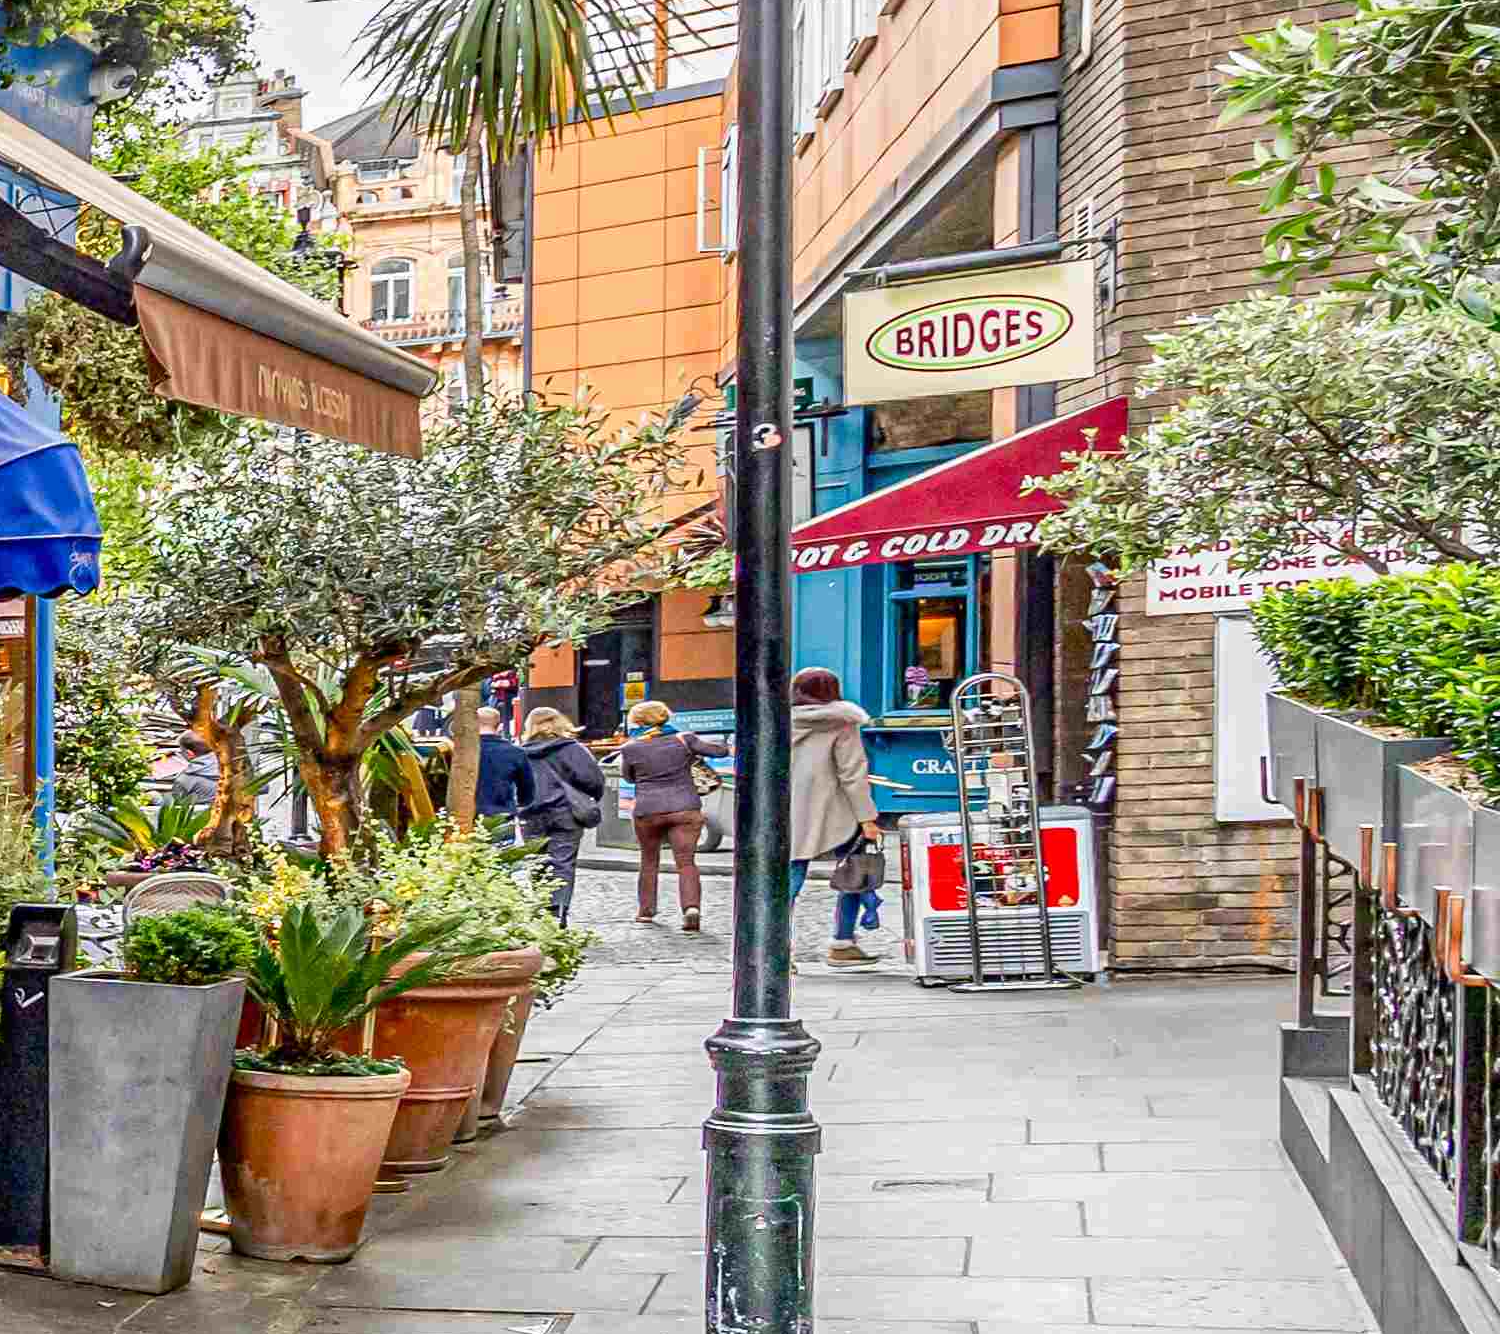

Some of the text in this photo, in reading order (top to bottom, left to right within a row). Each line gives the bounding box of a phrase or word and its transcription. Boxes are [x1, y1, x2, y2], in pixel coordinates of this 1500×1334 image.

[896, 309, 1044, 358] BRIDGES
[791, 543, 840, 568] OT
[880, 528, 971, 557] COLD
[1160, 563, 1202, 579] SIM
[1159, 583, 1253, 602] MOBILE
[911, 758, 982, 775] CRAT
